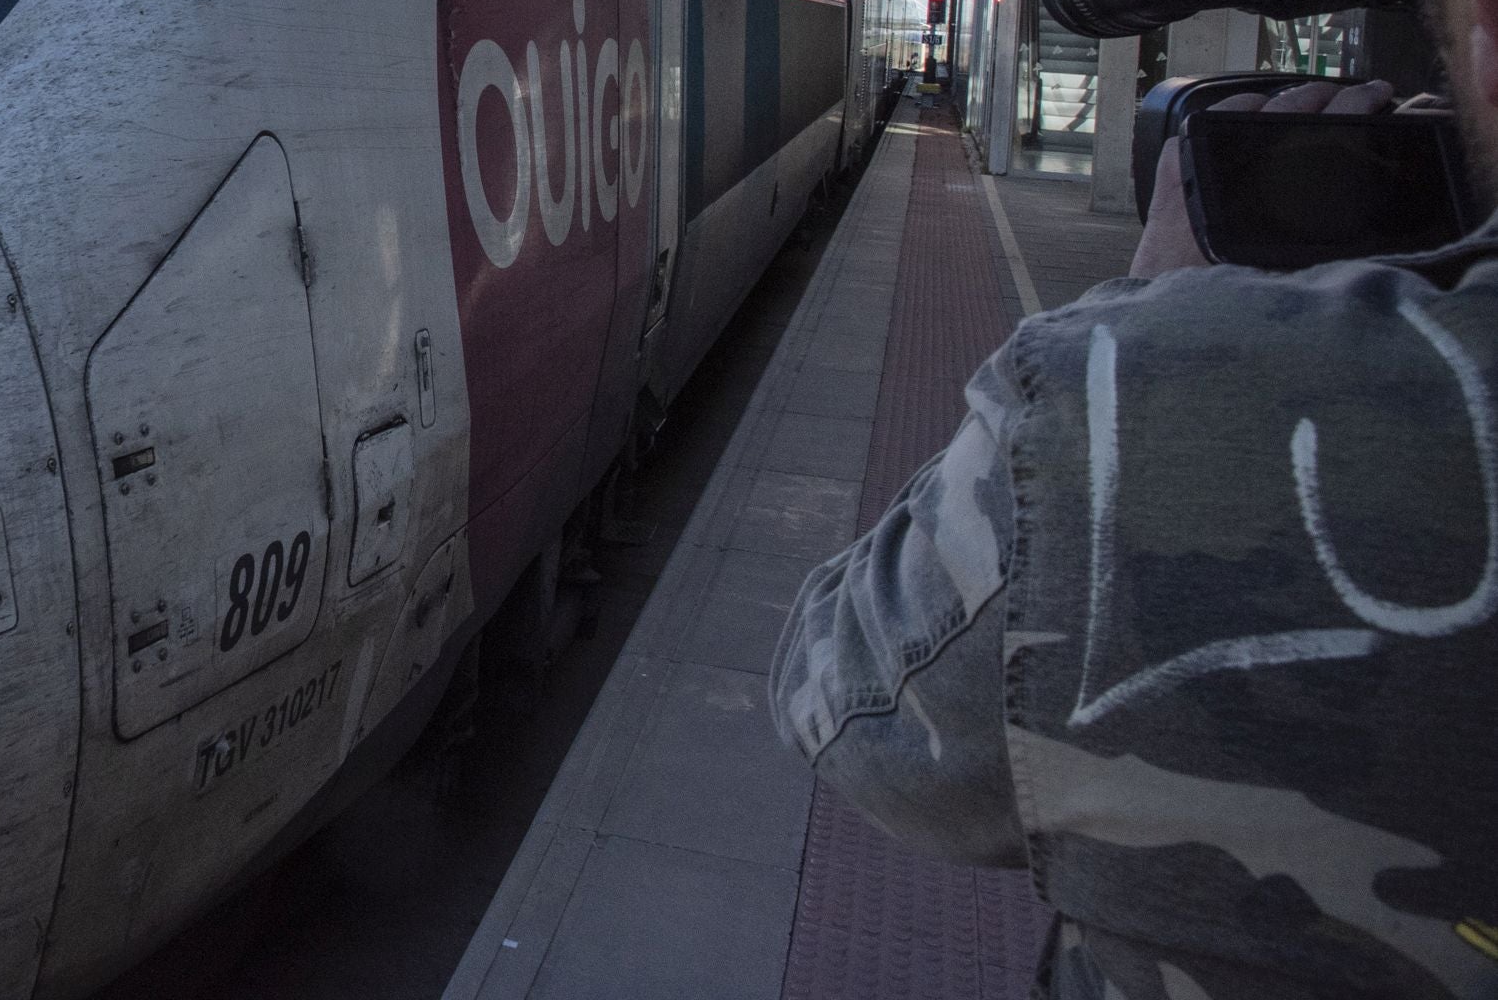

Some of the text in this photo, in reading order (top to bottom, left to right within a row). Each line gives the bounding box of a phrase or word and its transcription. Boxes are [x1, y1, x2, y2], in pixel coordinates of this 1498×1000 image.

[220, 530, 311, 651] 809
[199, 660, 343, 790] TGV 310217
